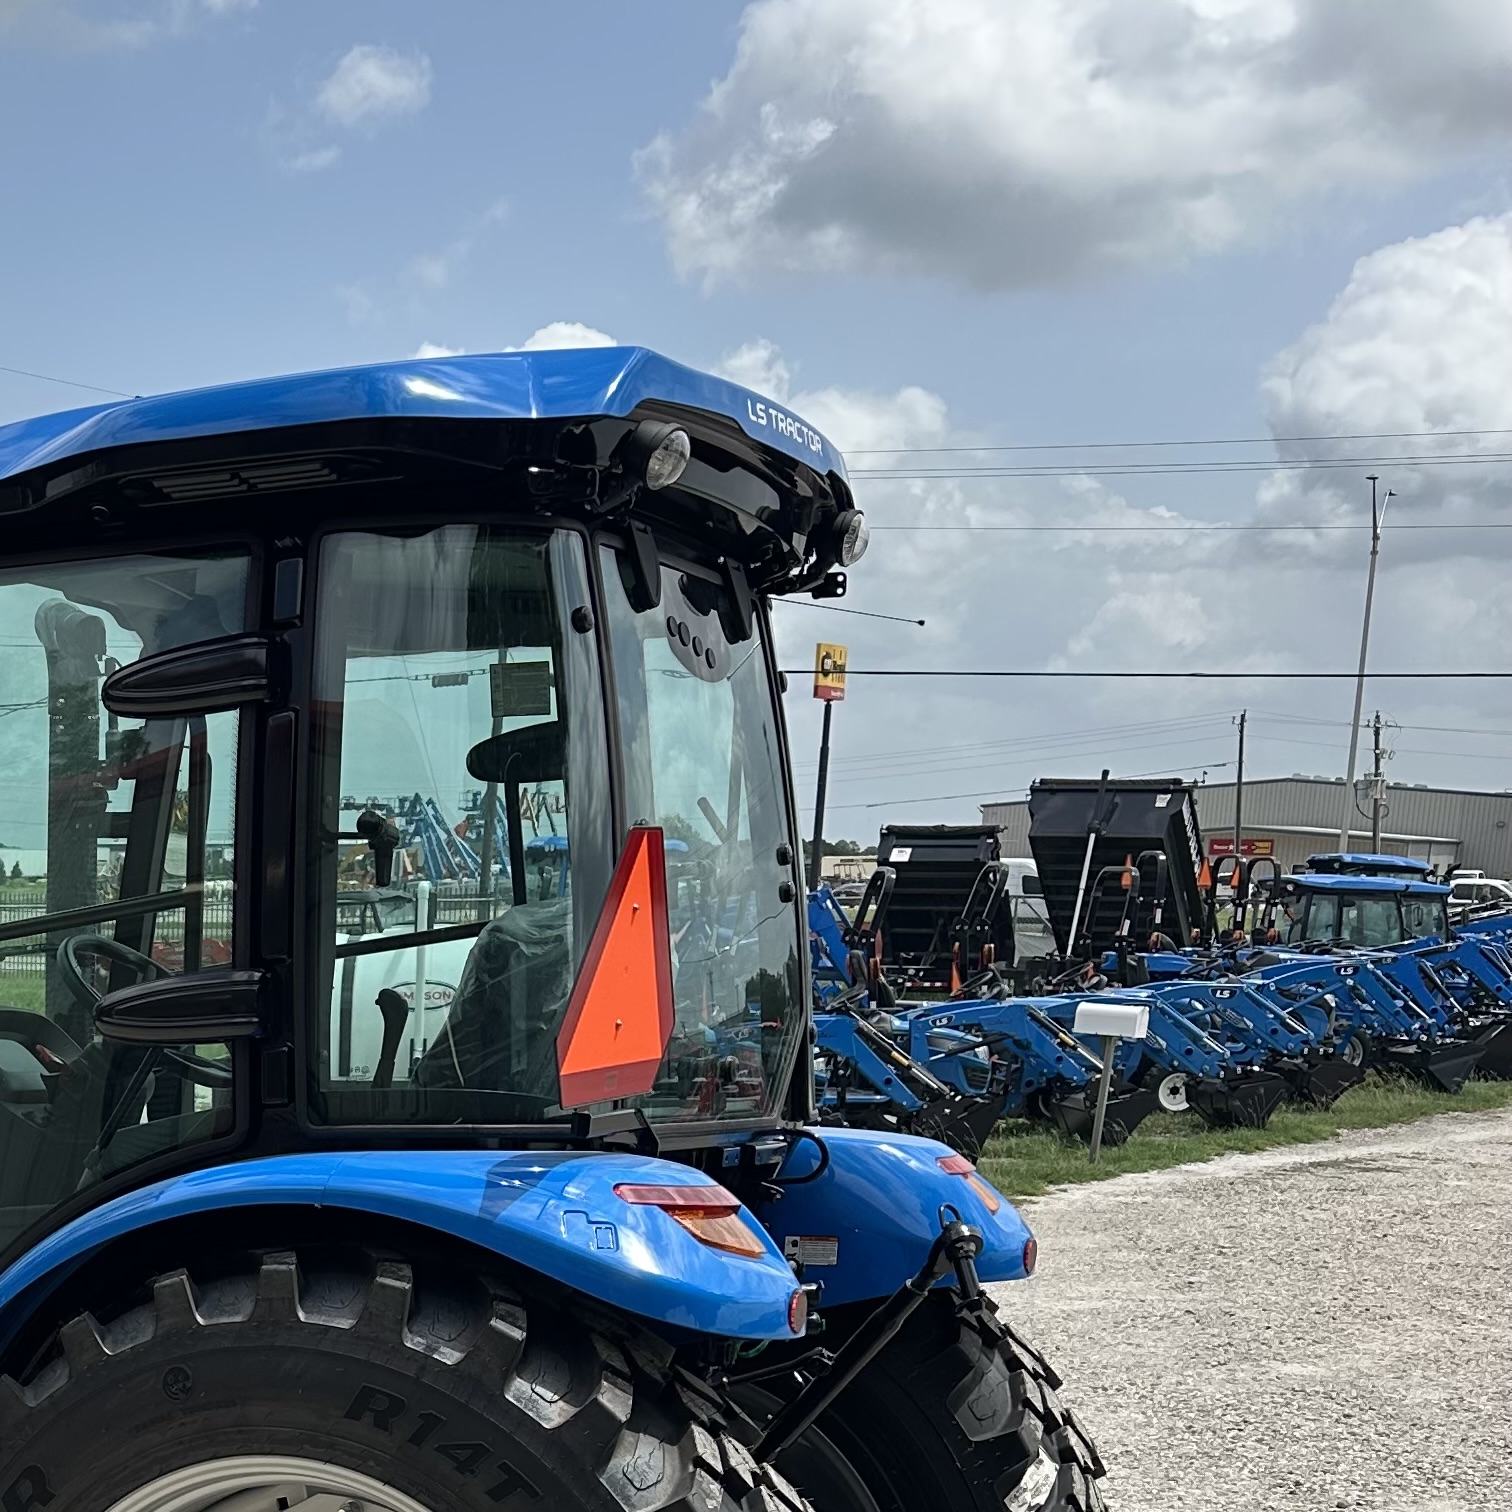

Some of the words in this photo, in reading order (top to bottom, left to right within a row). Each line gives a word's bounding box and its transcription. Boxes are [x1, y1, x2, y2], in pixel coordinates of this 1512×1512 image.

[747, 397, 767, 426] LS
[768, 407, 824, 457] TRACTOR
[1340, 967, 1354, 975] LS
[403, 991, 451, 1001] MSON
[1215, 989, 1231, 998] LS
[343, 1382, 544, 1504] R14T
